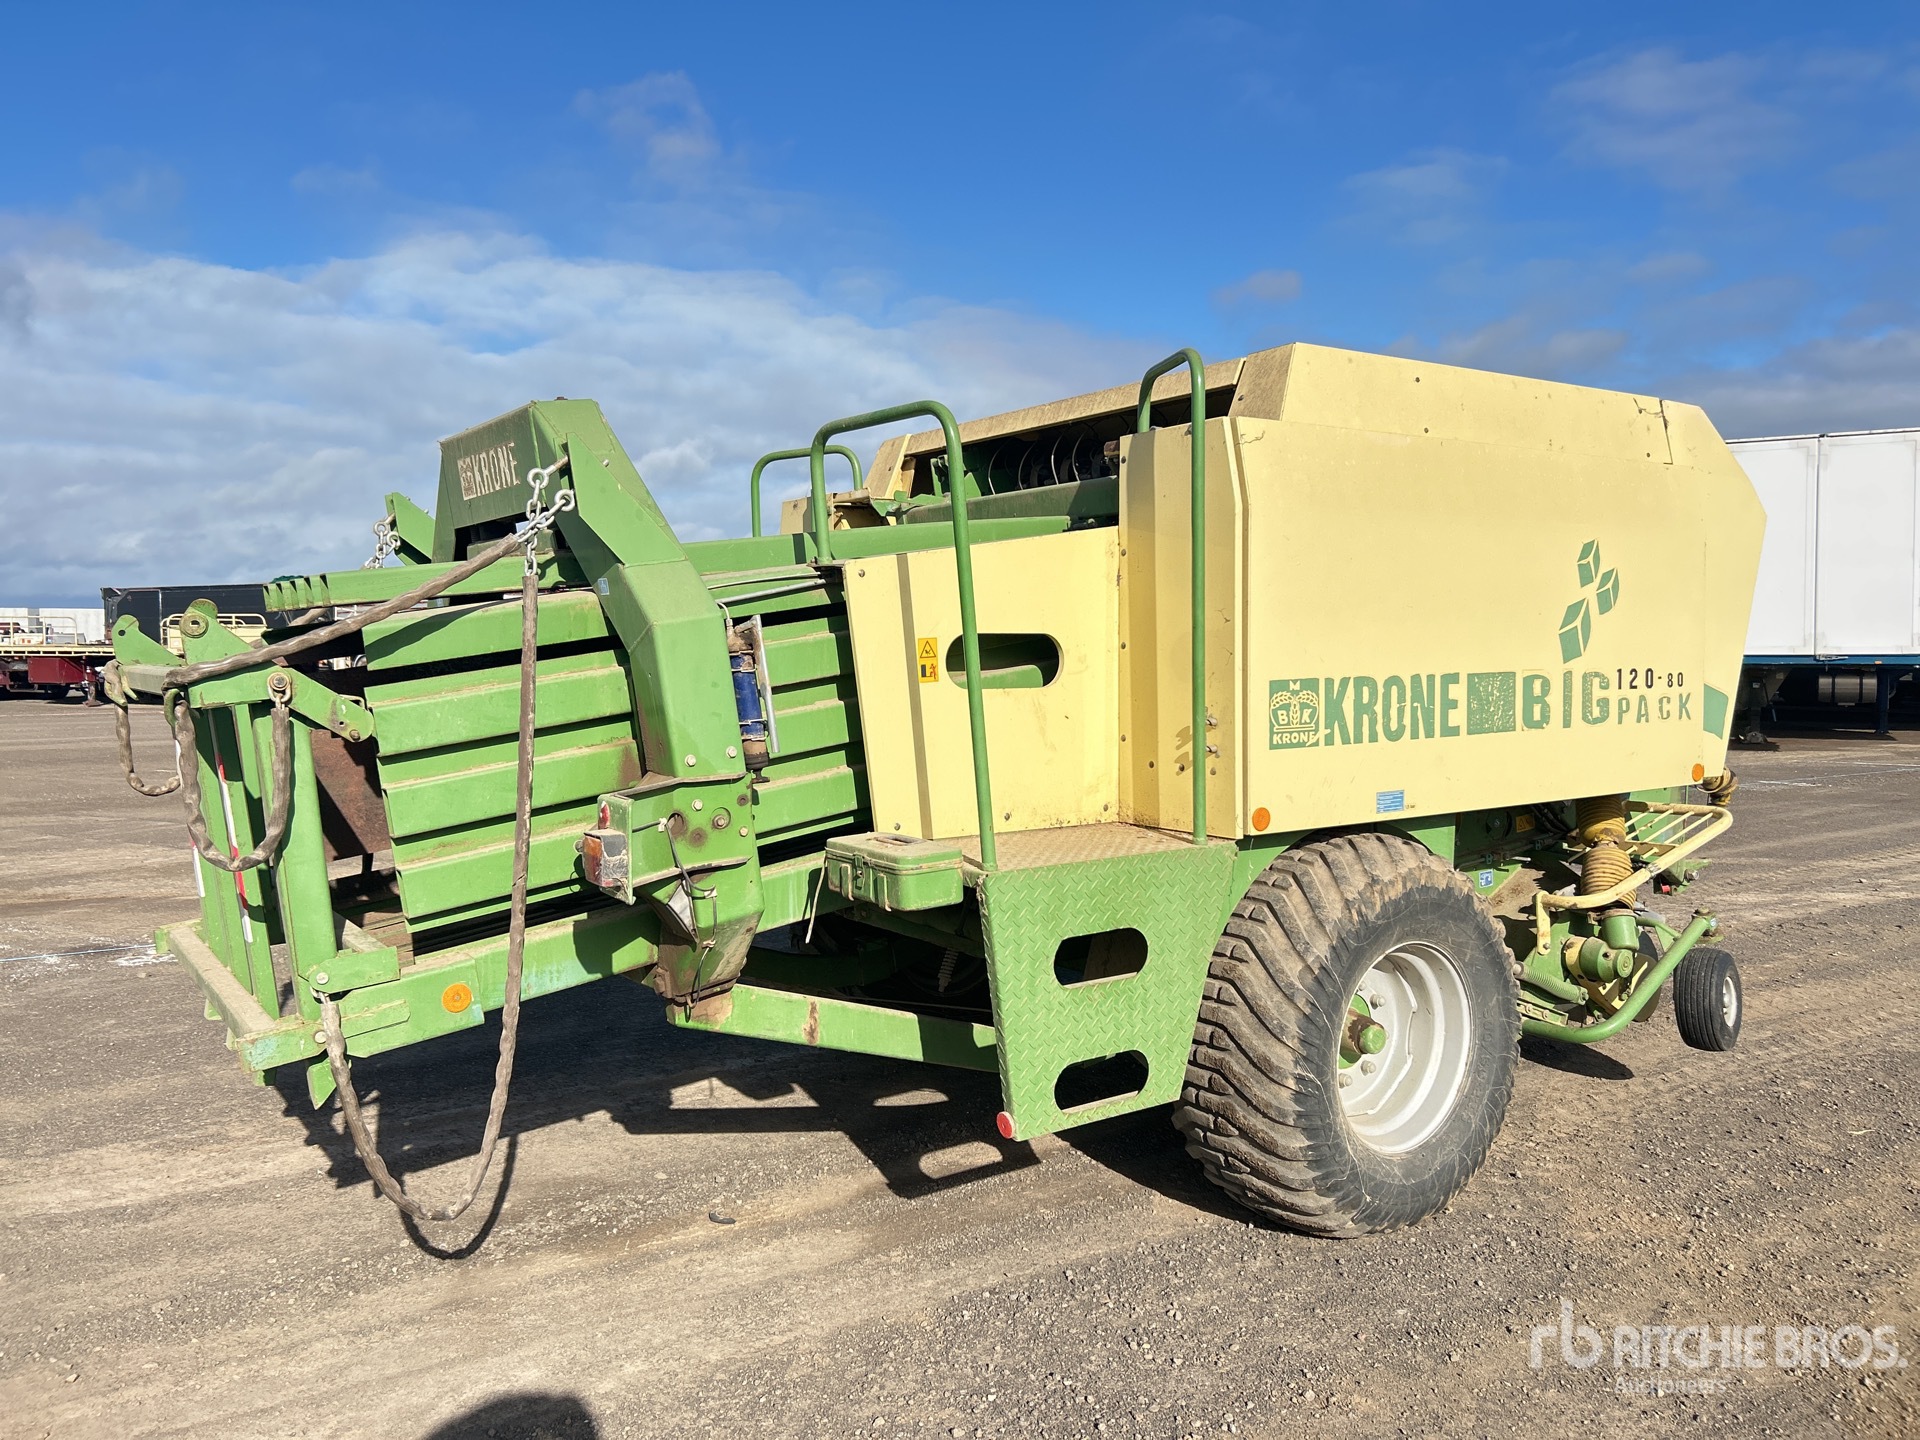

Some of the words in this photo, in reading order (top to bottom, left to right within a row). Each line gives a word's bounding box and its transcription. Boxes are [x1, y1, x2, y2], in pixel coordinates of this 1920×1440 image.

[471, 442, 520, 497] KRONE
[1324, 672, 1460, 746] KRONE
[1522, 669, 1610, 730] BIG
[1617, 692, 1692, 725] PACK
[1272, 731, 1317, 745] KRONE
